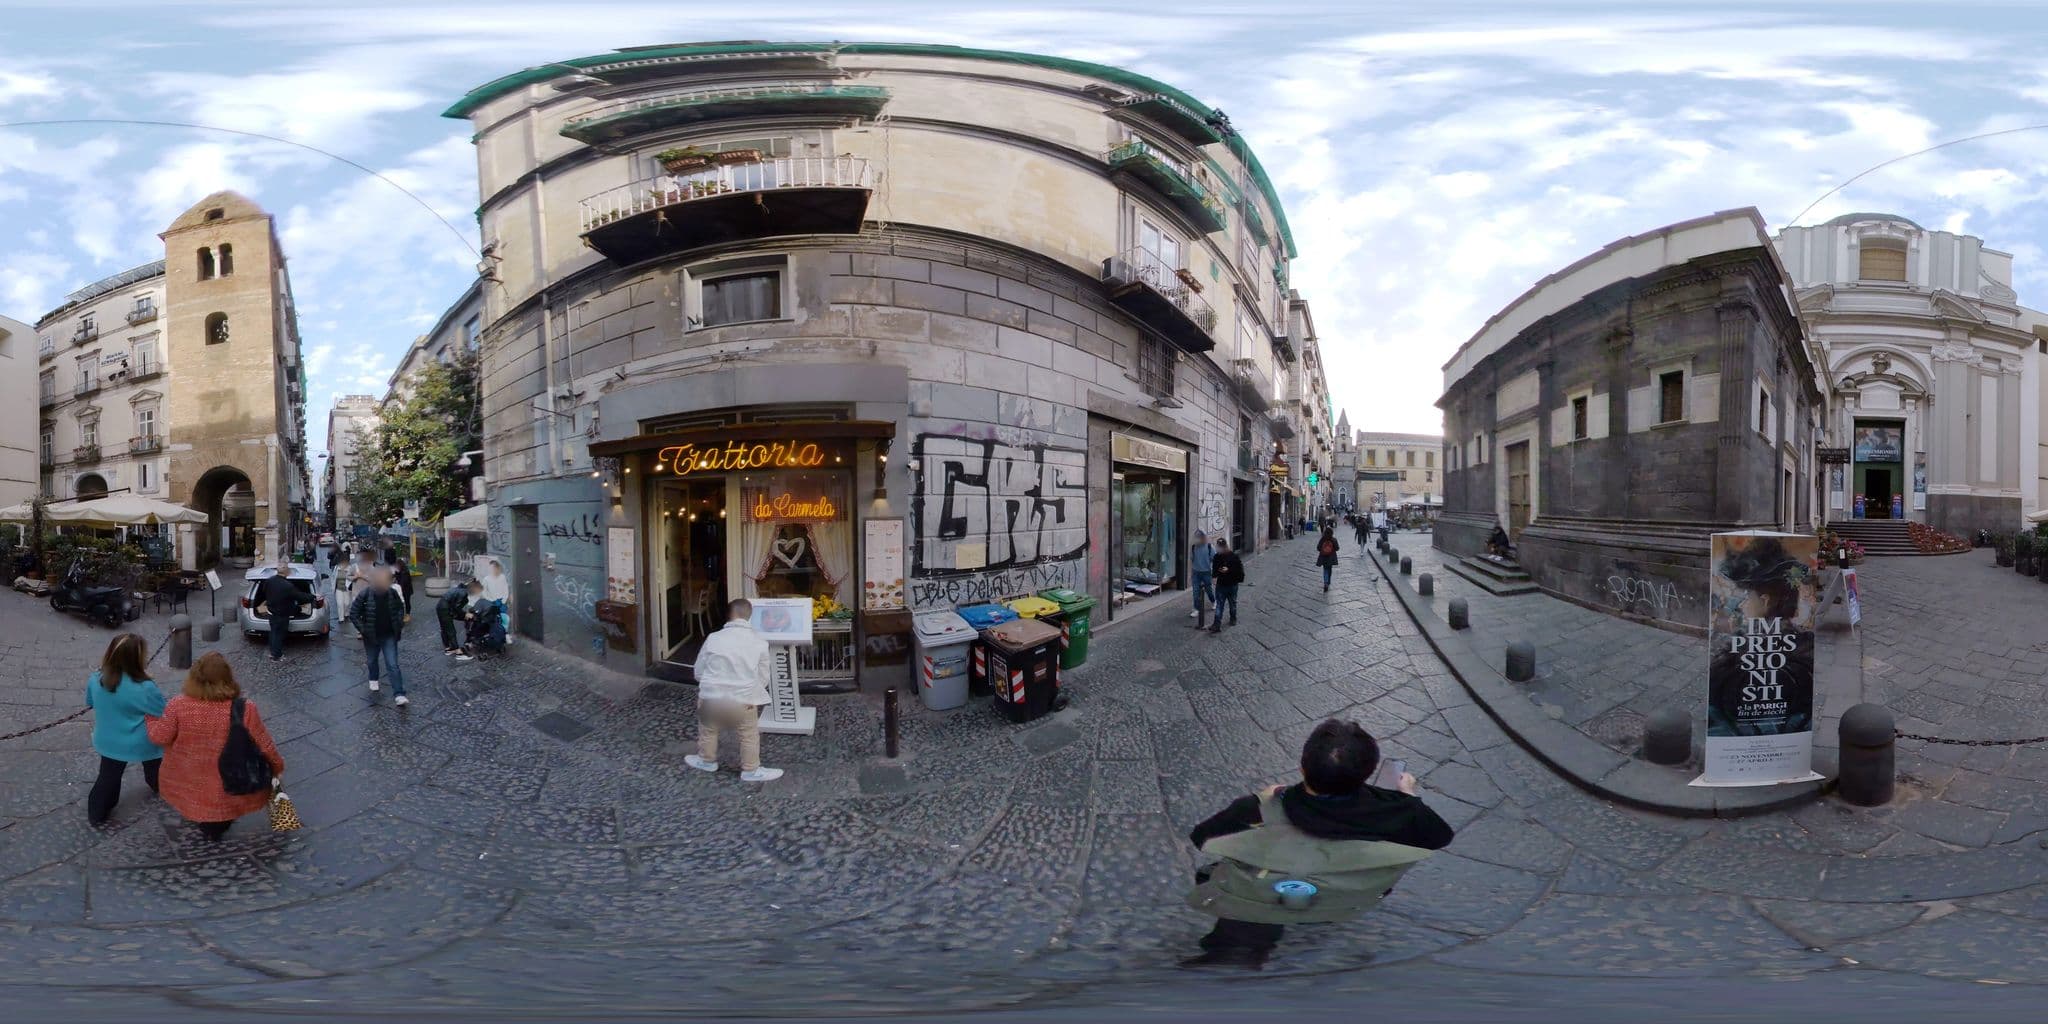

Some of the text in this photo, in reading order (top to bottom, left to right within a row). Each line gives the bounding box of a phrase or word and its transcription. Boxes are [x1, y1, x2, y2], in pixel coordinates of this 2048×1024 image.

[659, 440, 824, 476] Trattoria
[755, 493, 835, 518] da Carmela
[1746, 616, 1782, 635] IM
[1729, 634, 1797, 654] PRES
[1740, 652, 1787, 670] SIO
[1748, 669, 1780, 686] NI
[1742, 684, 1784, 702] STI
[1753, 702, 1788, 710] PARIGI
